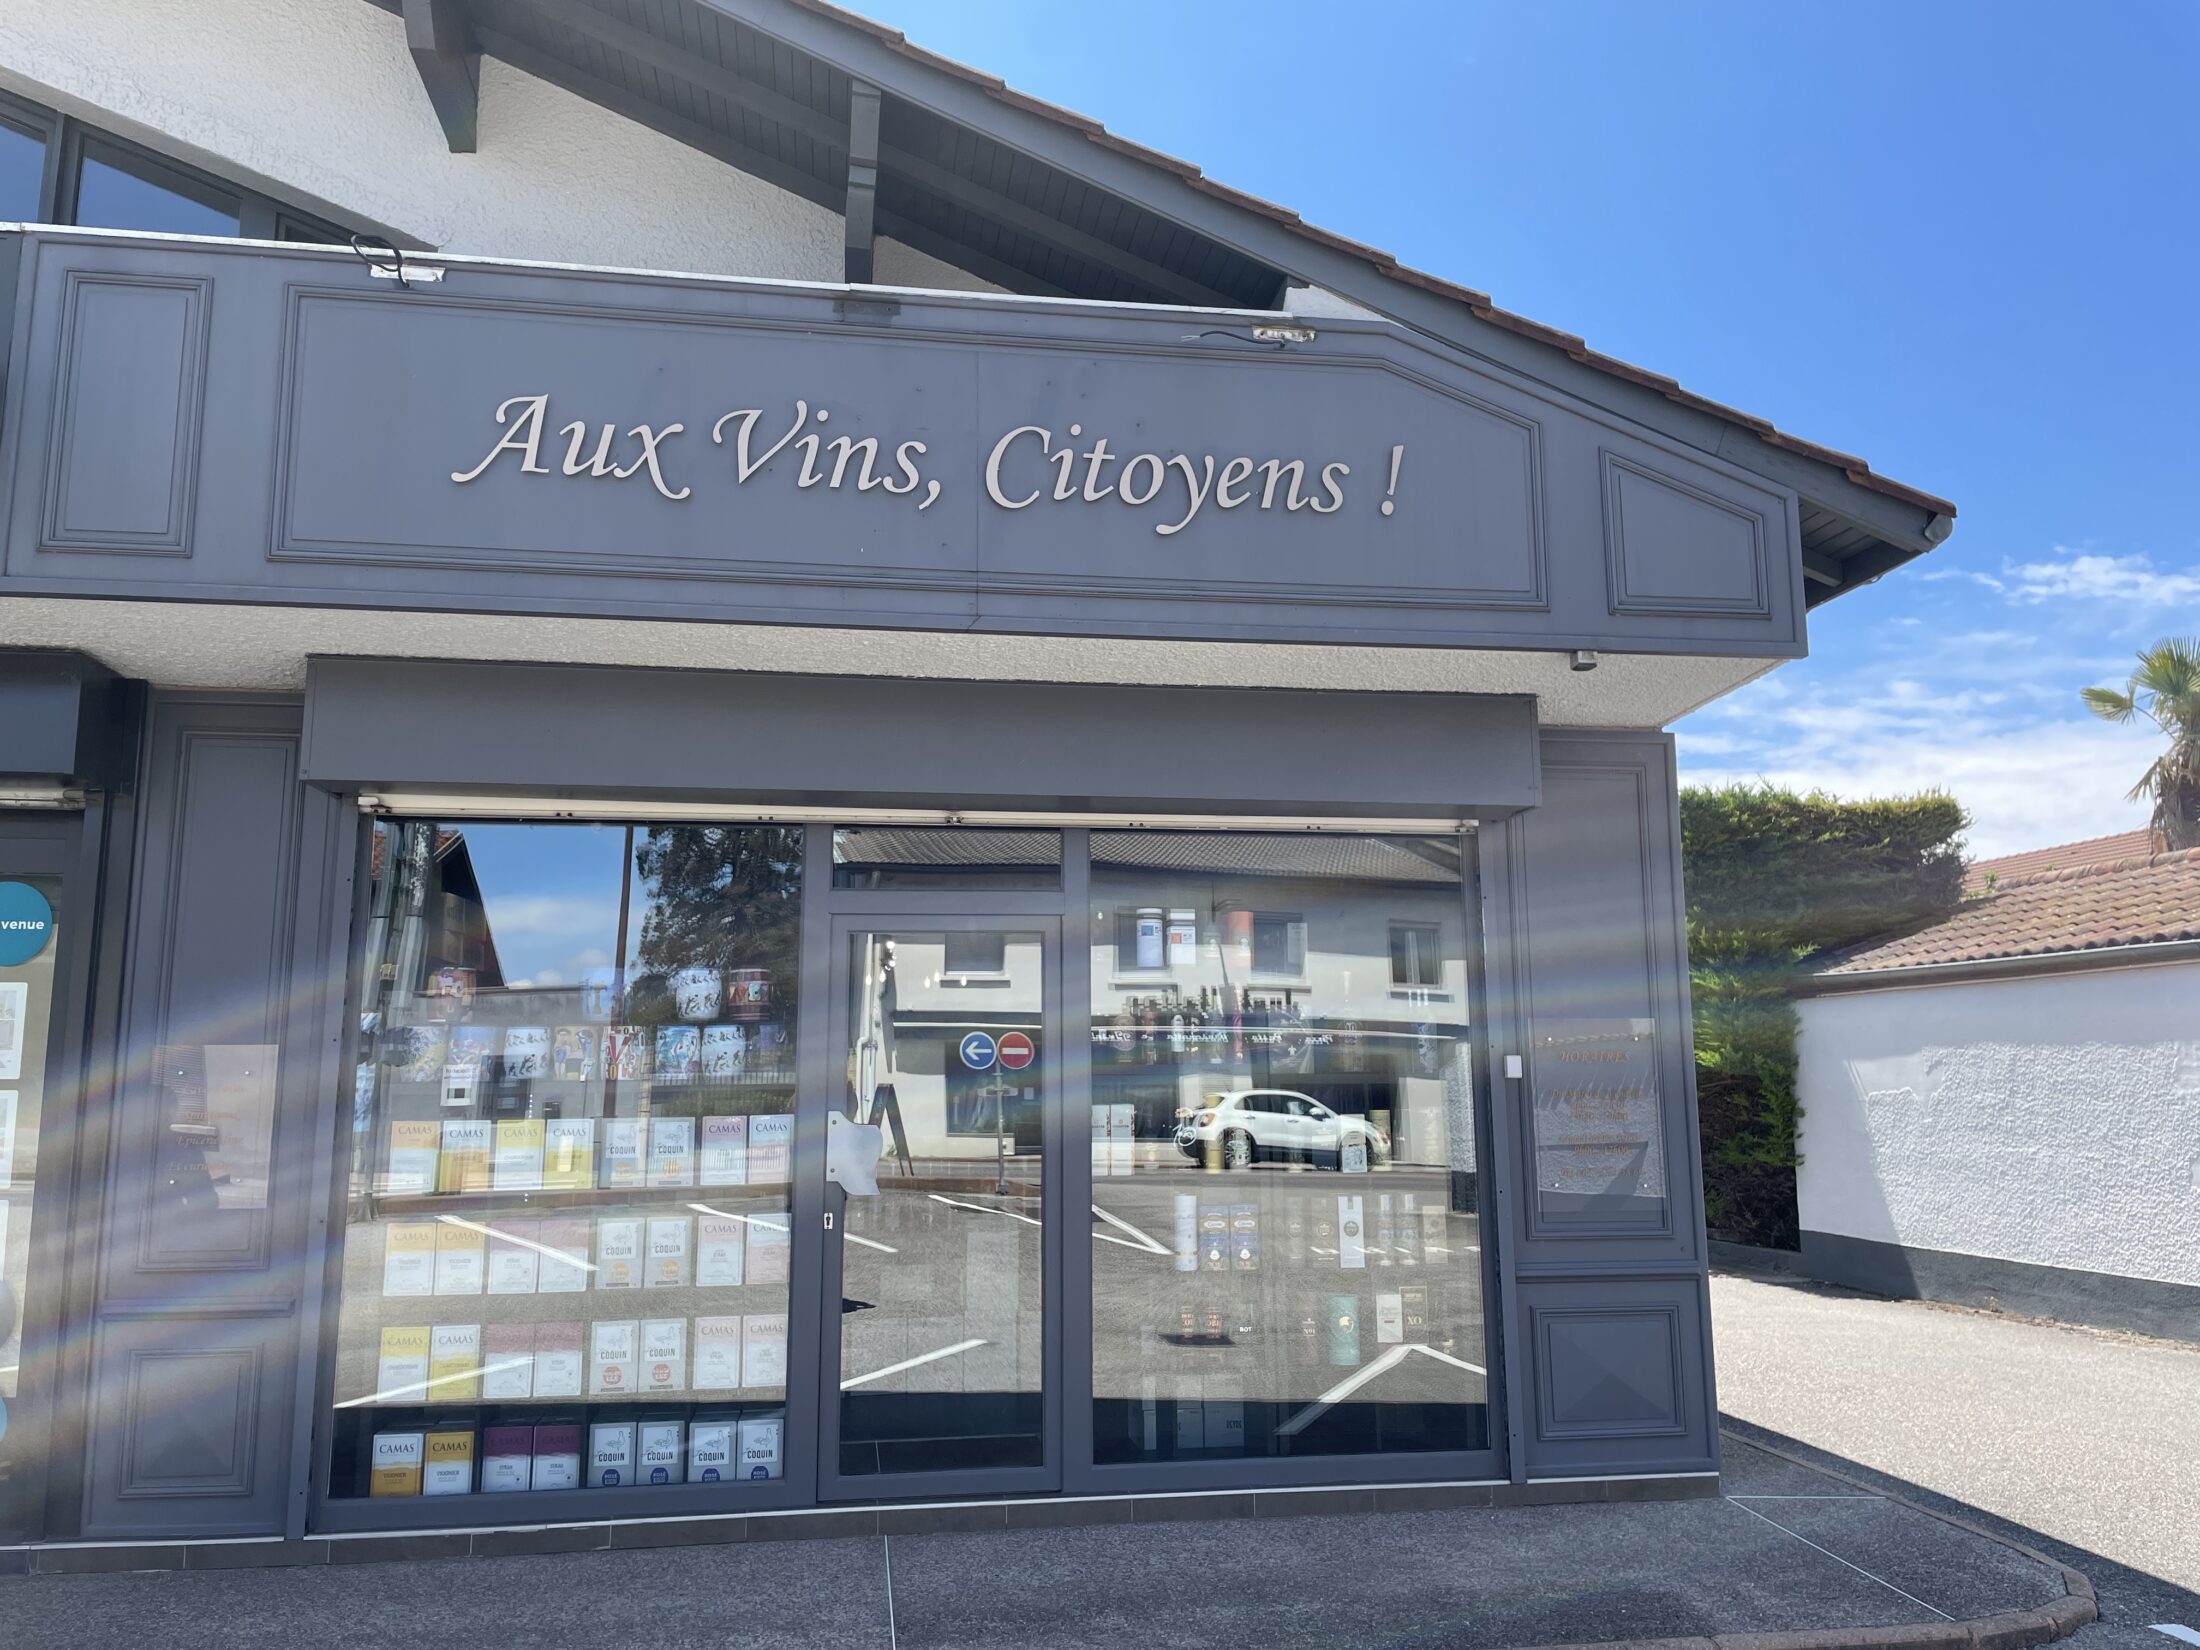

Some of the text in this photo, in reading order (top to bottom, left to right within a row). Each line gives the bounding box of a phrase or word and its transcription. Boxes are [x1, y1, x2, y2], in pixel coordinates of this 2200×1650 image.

[451, 393, 1405, 536] Aux Vins, Citoyens !
[1, 920, 45, 930] venue
[398, 1125, 432, 1135] CAMAS
[553, 1127, 587, 1138] CAMAS
[708, 1124, 741, 1134] CAMAS
[755, 1123, 788, 1132] CAMAS
[449, 1128, 484, 1139] CAMAS
[503, 1128, 538, 1138] CAMAS
[609, 1146, 636, 1155] COQUIN
[658, 1145, 684, 1154] COQUIN
[704, 1224, 737, 1233] CAMAS
[394, 1232, 430, 1242] CAMAS
[444, 1231, 479, 1241] CAMAS
[605, 1246, 632, 1256] COQUIN
[654, 1245, 681, 1254] COQUIN
[701, 1326, 735, 1336] CAMAS
[750, 1324, 784, 1334] CAMAS
[387, 1335, 423, 1345] CAMAS
[438, 1335, 474, 1345] CAMAS
[600, 1351, 627, 1360] COQUIN
[649, 1348, 676, 1358] COQUIN
[379, 1443, 415, 1454] CAMAS
[432, 1441, 467, 1452] CAMAS
[598, 1452, 625, 1462] COQUIN
[647, 1450, 673, 1461] COQUIN
[698, 1452, 725, 1462] COQUIN
[747, 1449, 773, 1459] COQUIN
